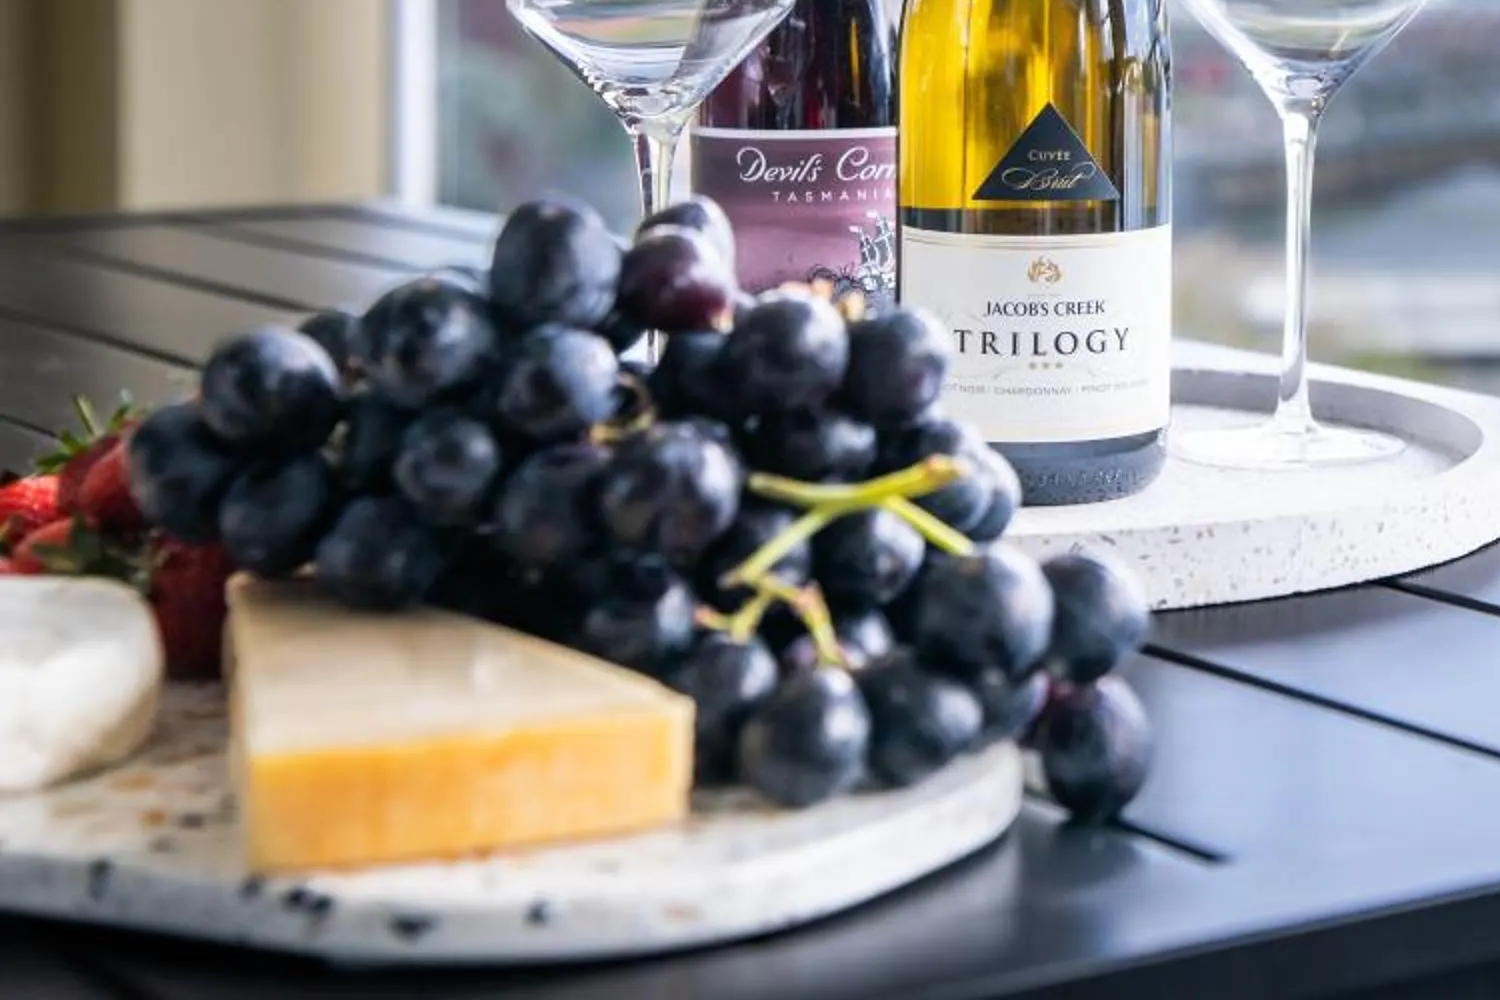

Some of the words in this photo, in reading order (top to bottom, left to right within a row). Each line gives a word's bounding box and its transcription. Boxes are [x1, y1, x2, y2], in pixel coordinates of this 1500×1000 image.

[736, 145, 824, 182] Devil's
[1001, 161, 1097, 190] Brut
[772, 188, 893, 203] TASMANIA
[983, 300, 1049, 317] JACOB'S
[1053, 299, 1105, 316] CREEK
[953, 327, 1130, 356] TRILOGY
